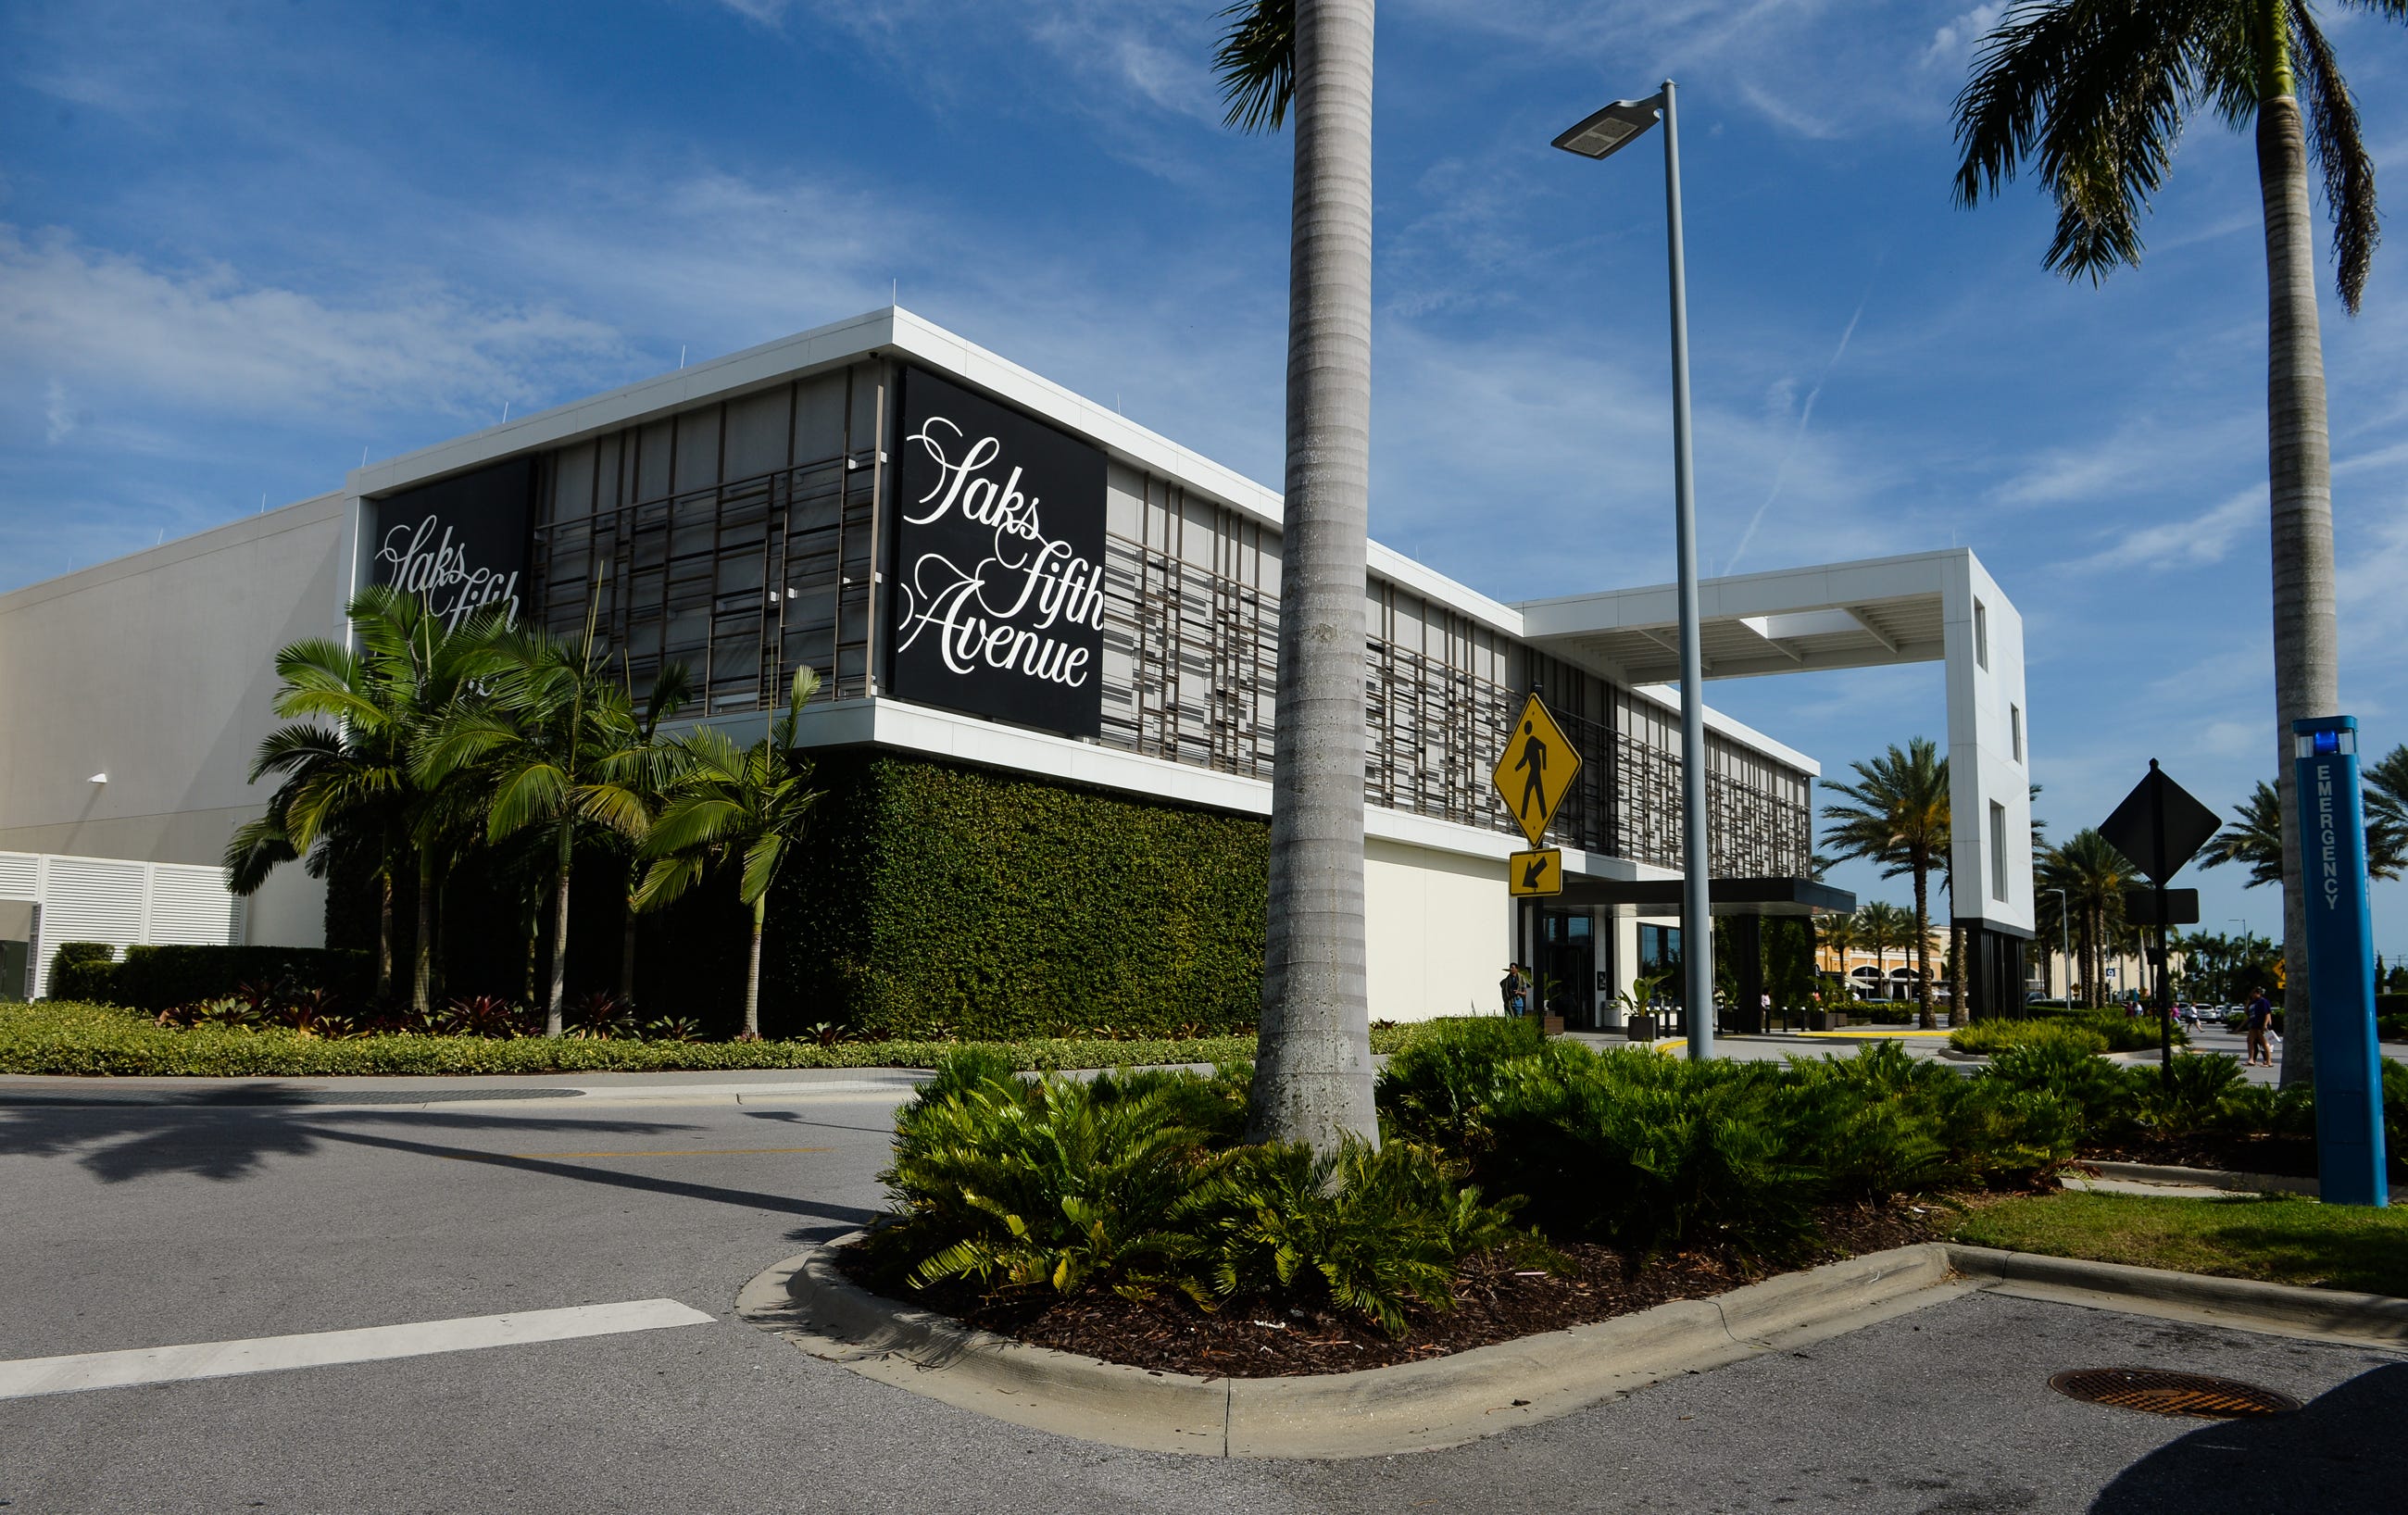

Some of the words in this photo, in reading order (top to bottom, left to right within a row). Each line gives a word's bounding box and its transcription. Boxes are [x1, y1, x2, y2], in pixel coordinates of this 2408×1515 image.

[903, 416, 1039, 540] Saks
[375, 515, 465, 600] Saks
[429, 567, 520, 647] Fih
[975, 519, 1104, 631] Fifth
[898, 553, 1089, 687] Avenue
[2317, 765, 2339, 910] EMERGENCY
